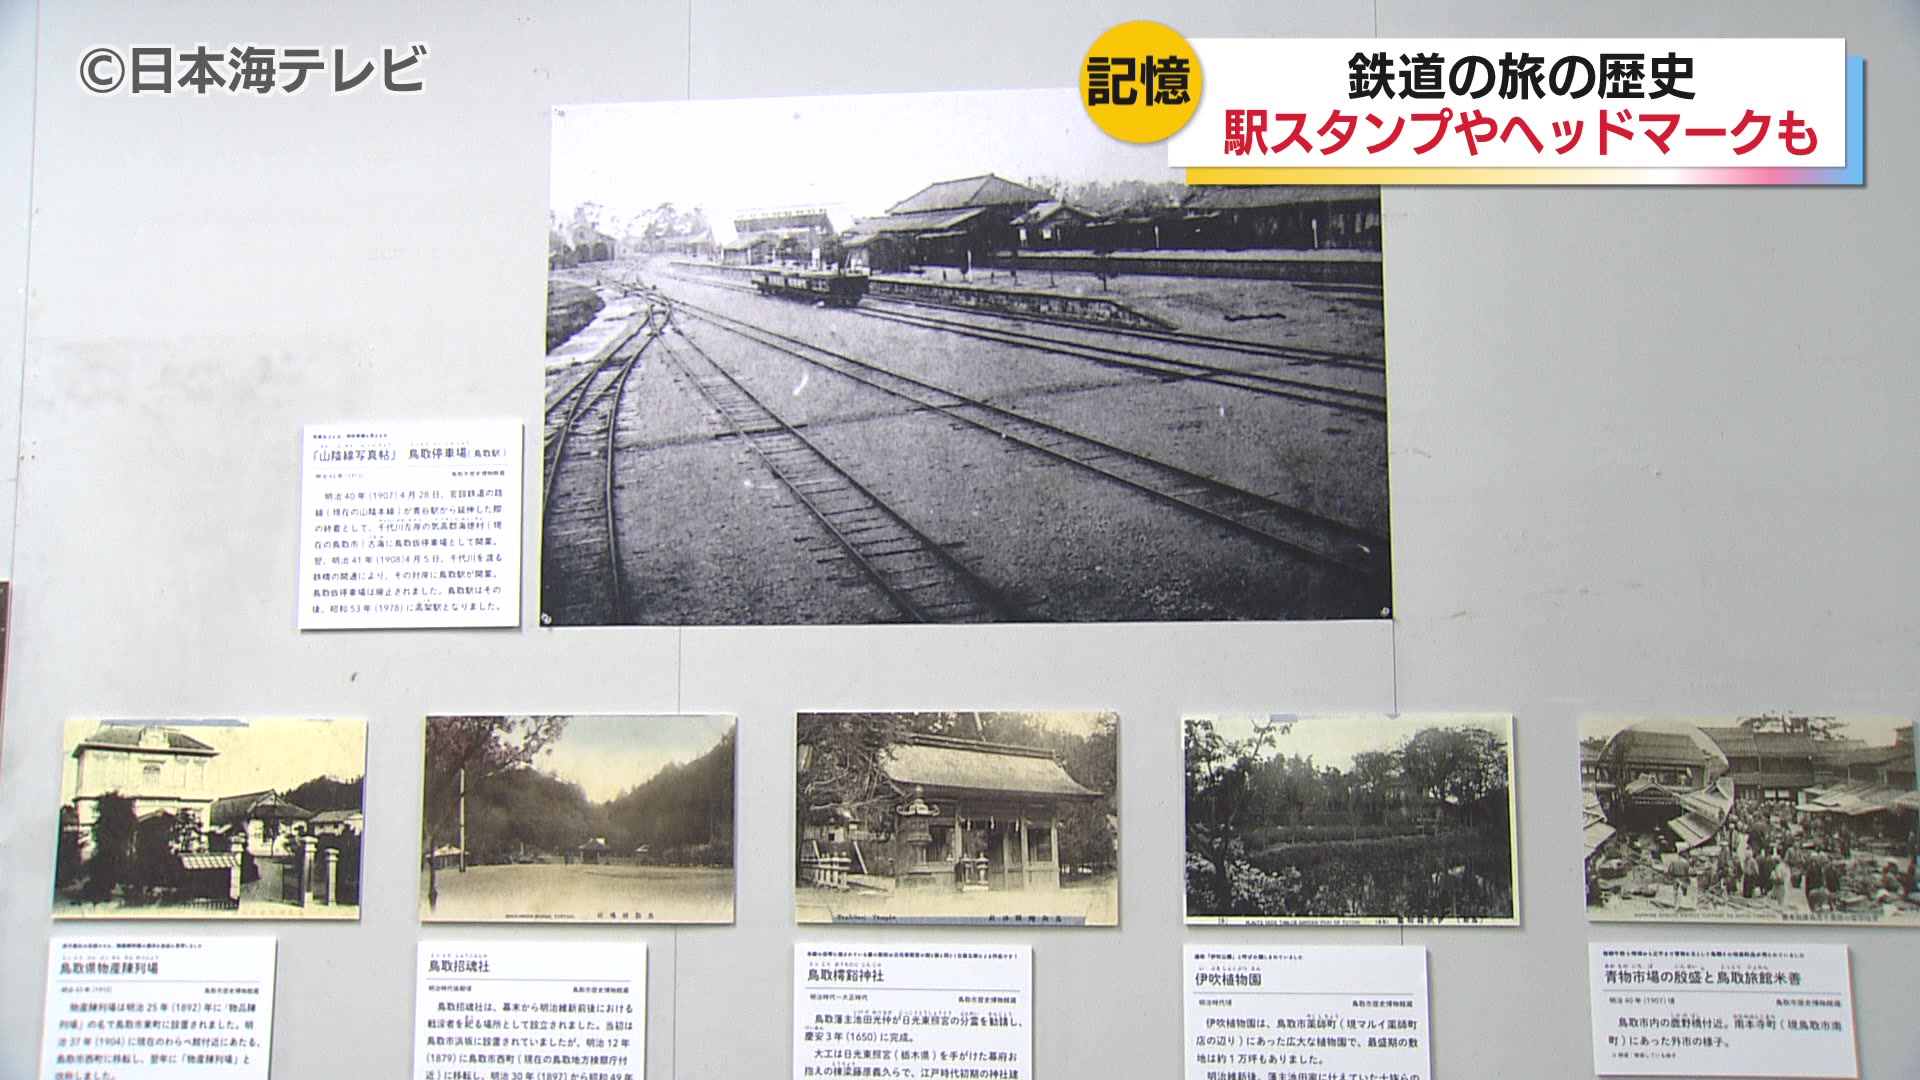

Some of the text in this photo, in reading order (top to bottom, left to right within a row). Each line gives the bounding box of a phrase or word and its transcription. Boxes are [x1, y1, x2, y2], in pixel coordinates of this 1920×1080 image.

[60, 962, 159, 975] 鳥取県物産陳列場
[428, 959, 490, 973] 鳥取招魂社
[1195, 972, 1262, 986] 伊吹植物園
[1608, 1035, 1729, 1049] 町)にあった外市の様子。
[1196, 1053, 1324, 1065] 地は約1万坪もありました。
